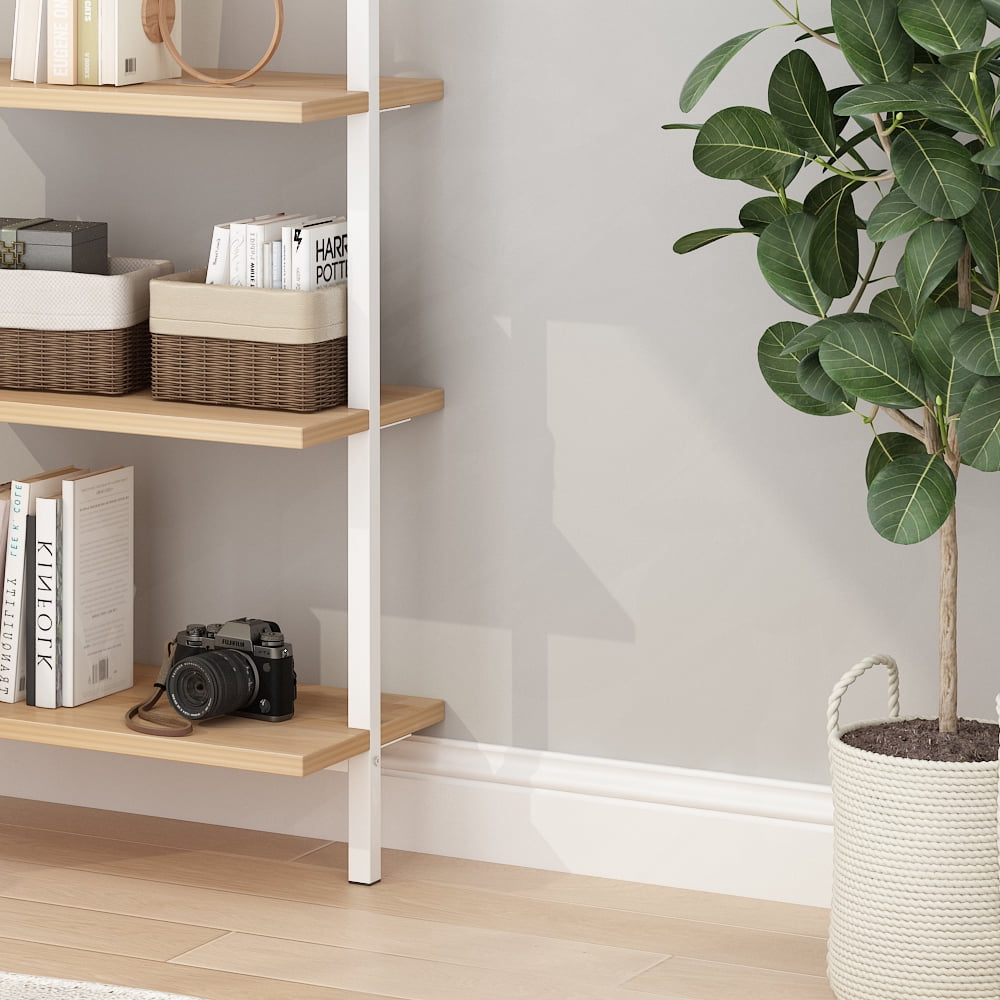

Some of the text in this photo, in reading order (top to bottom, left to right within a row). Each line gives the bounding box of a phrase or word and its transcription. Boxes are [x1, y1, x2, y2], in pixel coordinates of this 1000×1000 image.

[53, 23, 68, 77] EUGENE
[316, 233, 348, 263] HARR
[316, 258, 348, 285] POTT
